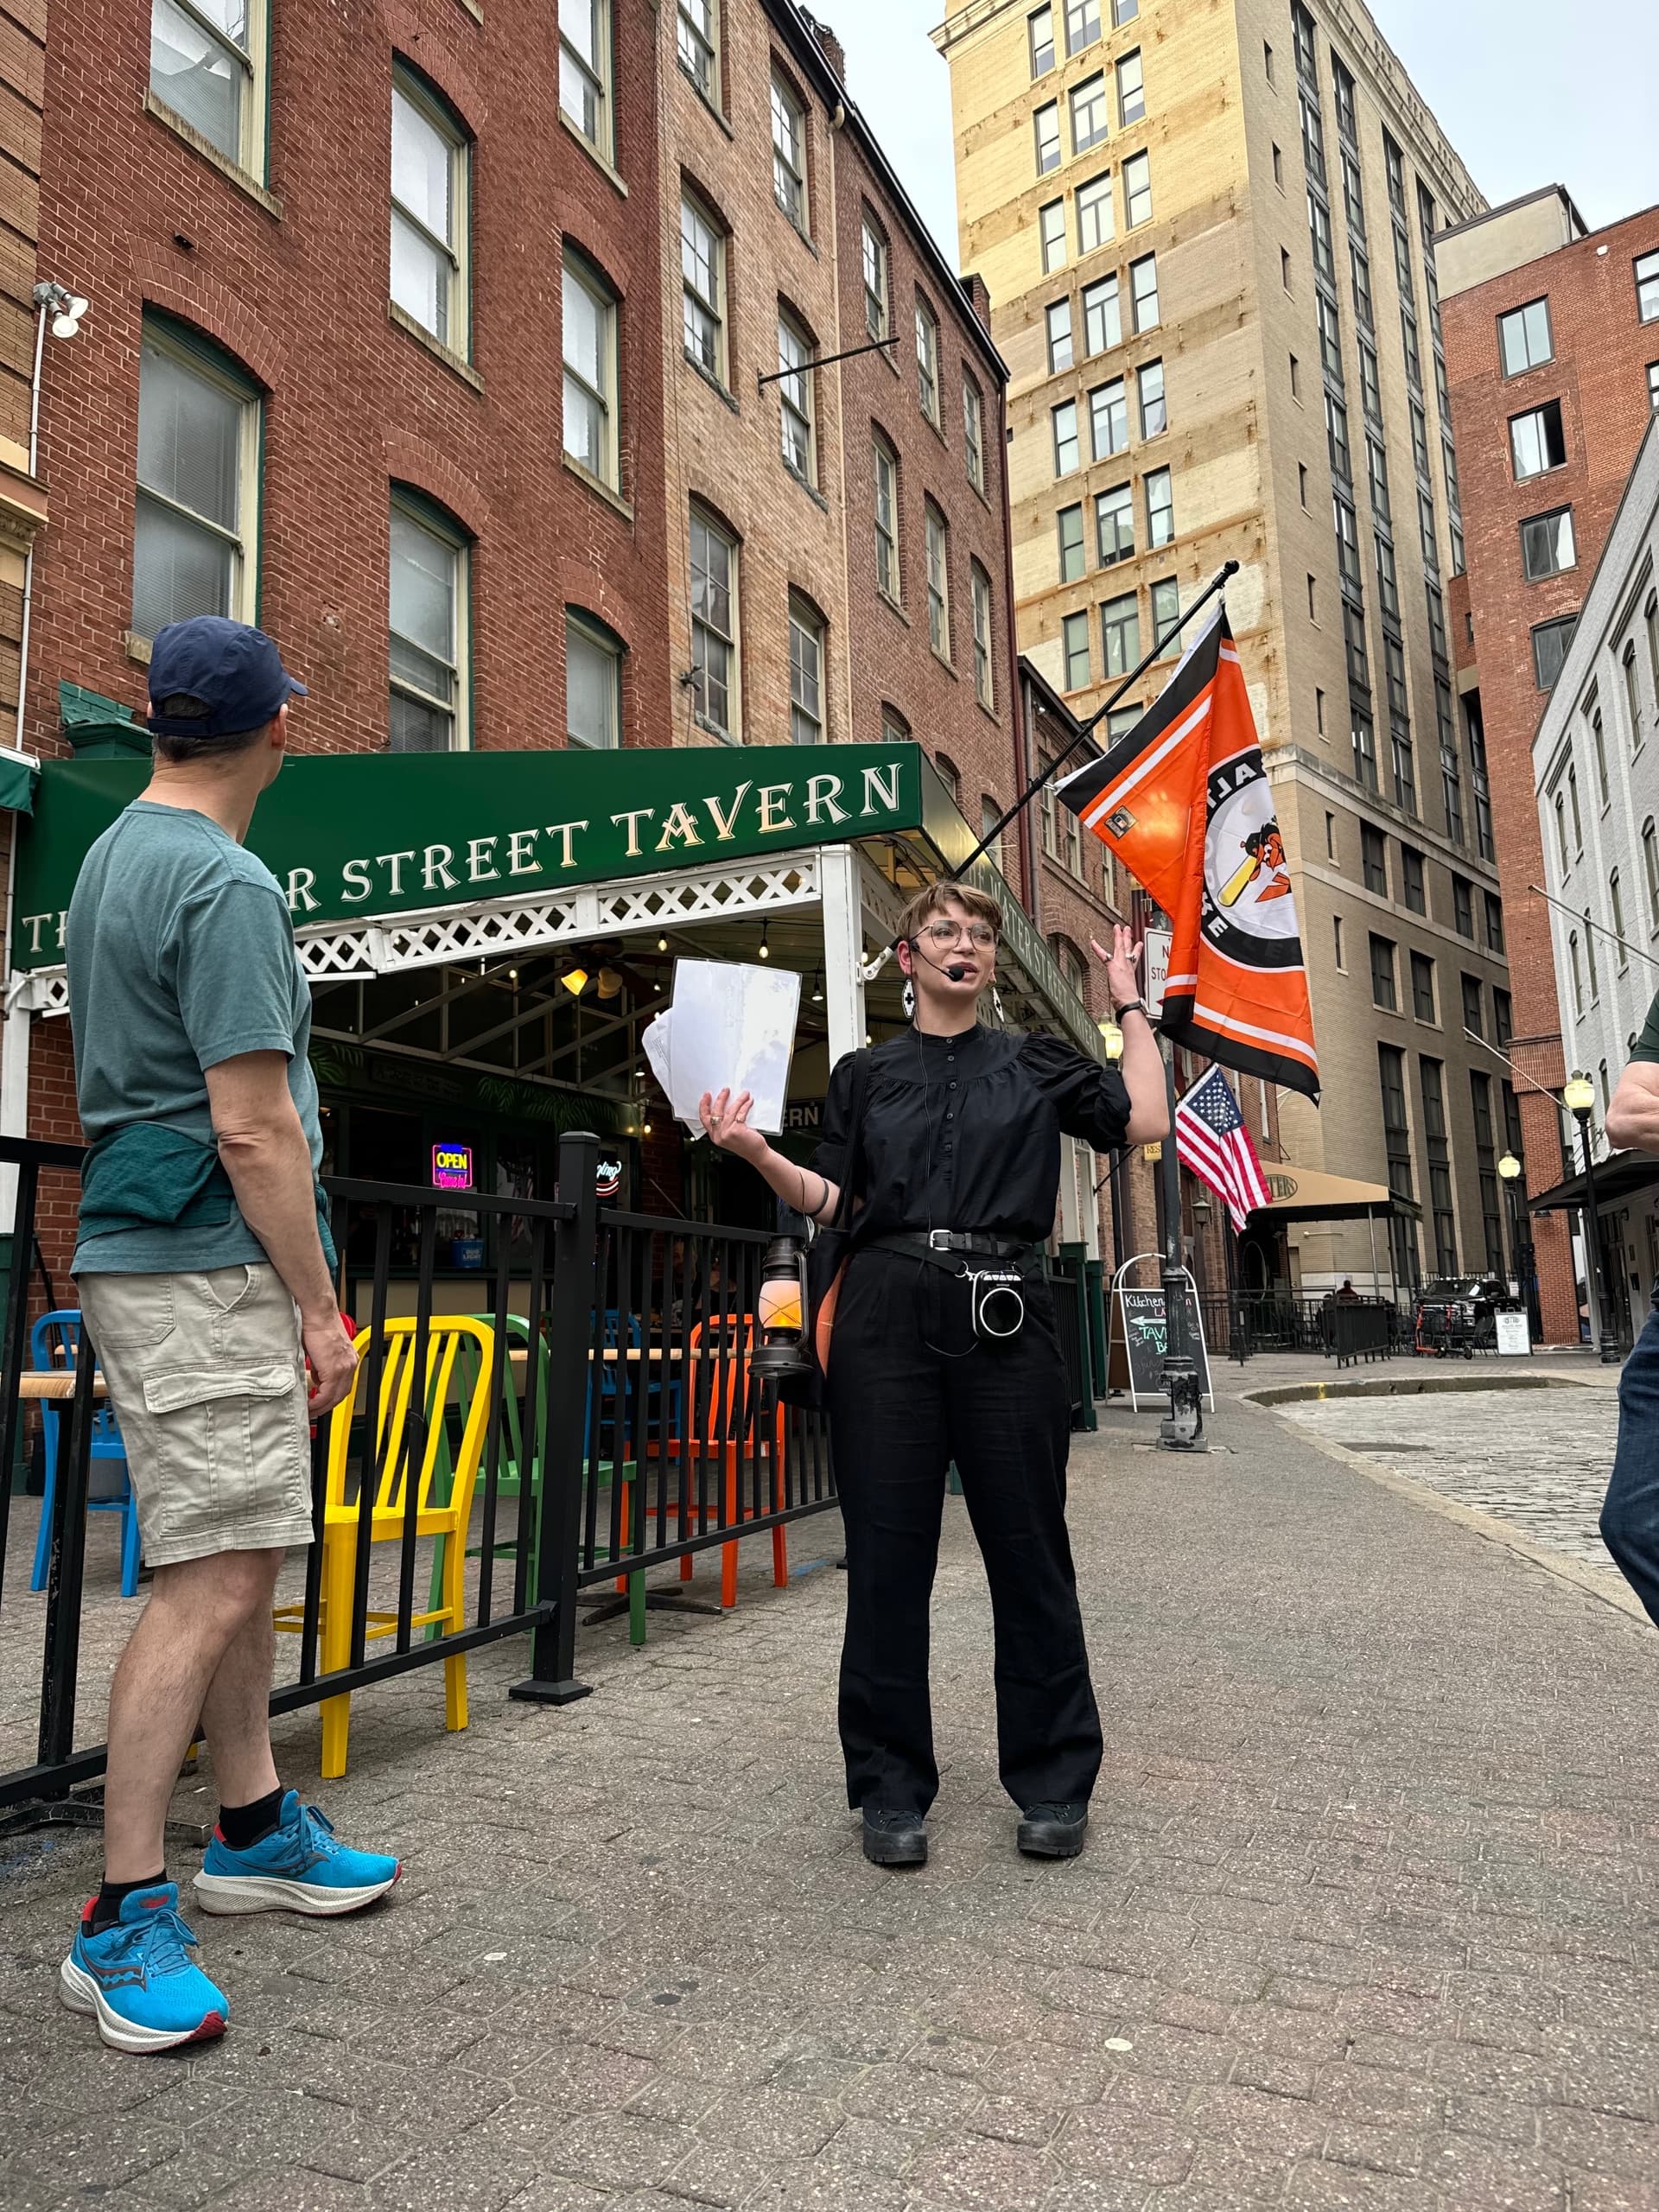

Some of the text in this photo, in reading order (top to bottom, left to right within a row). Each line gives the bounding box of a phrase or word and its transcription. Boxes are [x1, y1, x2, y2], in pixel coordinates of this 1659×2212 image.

[340, 820, 588, 903] STREET
[610, 763, 904, 856] TAVERN
[989, 874, 1032, 968] WATER
[1034, 942, 1068, 1017] STREET
[1071, 998, 1097, 1057] TAVERN
[436, 1152, 467, 1169] OPEN
[1125, 1294, 1164, 1307] Kitchen
